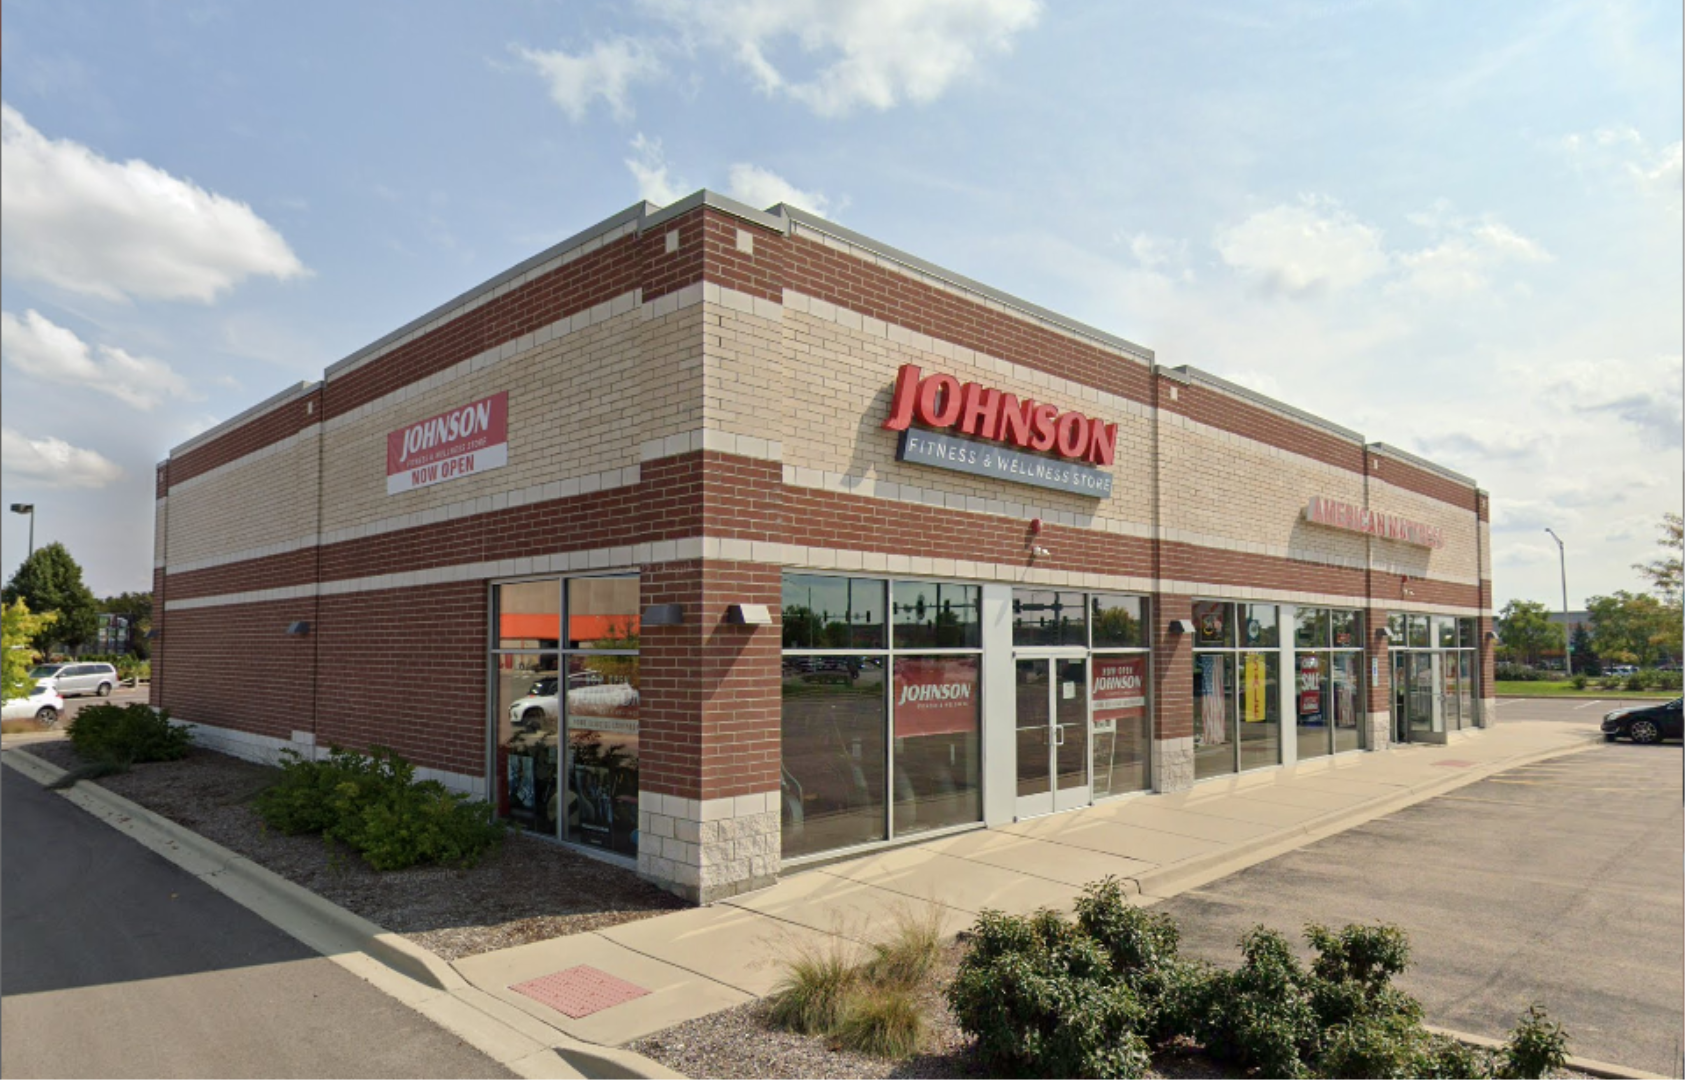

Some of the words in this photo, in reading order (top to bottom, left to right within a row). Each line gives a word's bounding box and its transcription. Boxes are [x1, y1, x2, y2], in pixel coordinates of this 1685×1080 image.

[400, 400, 492, 463] JOHNSON
[881, 362, 1119, 467] JOHNSON
[412, 465, 437, 485] NOW
[442, 455, 474, 478] OPEN
[907, 438, 977, 465] FITNESS
[982, 453, 993, 468] &
[997, 456, 1070, 483] WELLNESS
[1072, 473, 1112, 493] STORE
[1308, 496, 1386, 536] AMERICAN
[898, 682, 972, 706] JOHNSON
[1092, 674, 1143, 695] JOHNSON
[1301, 672, 1320, 691] SALE
